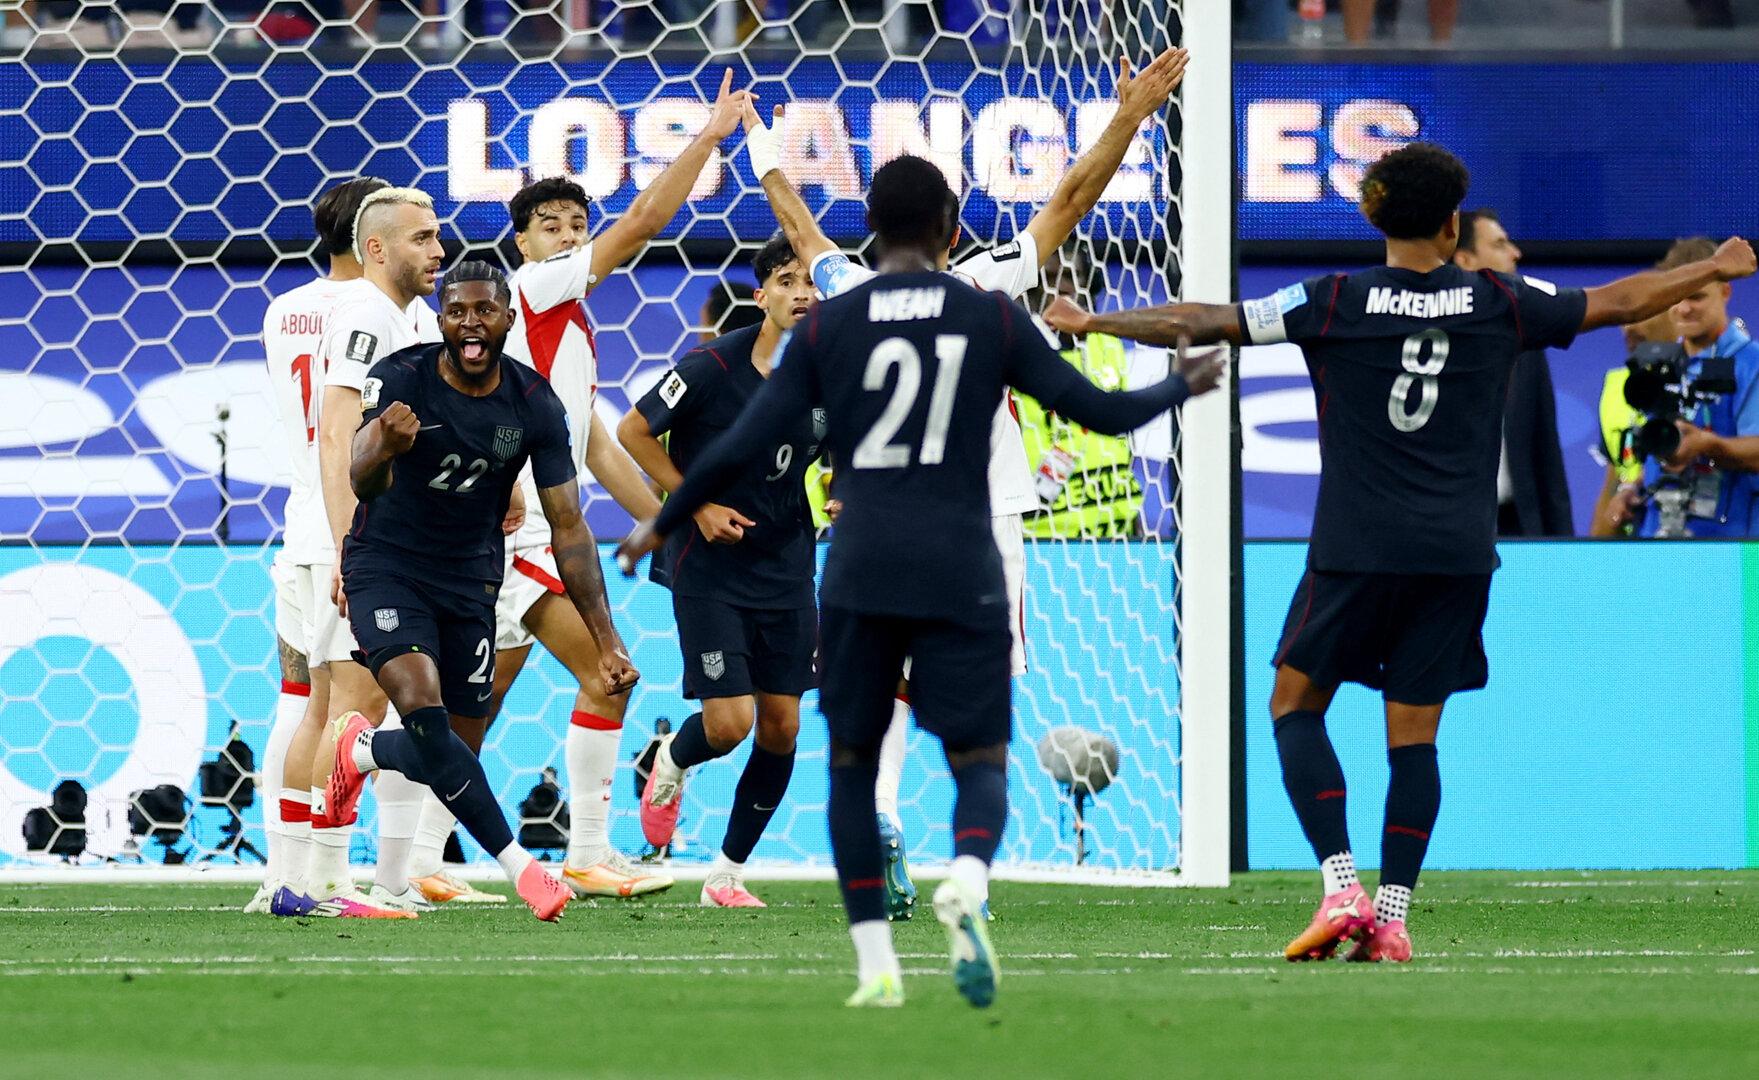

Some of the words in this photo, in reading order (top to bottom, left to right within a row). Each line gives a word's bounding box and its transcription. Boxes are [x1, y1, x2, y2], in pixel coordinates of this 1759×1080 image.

[447, 98, 722, 202] LOS
[778, 98, 1421, 203] ANGEES
[868, 286, 946, 322] WEAH
[1366, 286, 1474, 318] McKENNIE
[1388, 328, 1450, 432] 8
[291, 353, 329, 447] 1
[814, 410, 826, 423] US
[852, 334, 968, 469] 21
[497, 428, 522, 443] USA
[428, 453, 489, 493] 22
[765, 444, 793, 482] 9
[376, 610, 396, 619] USA
[467, 637, 496, 684] 2
[703, 653, 721, 665] USA
